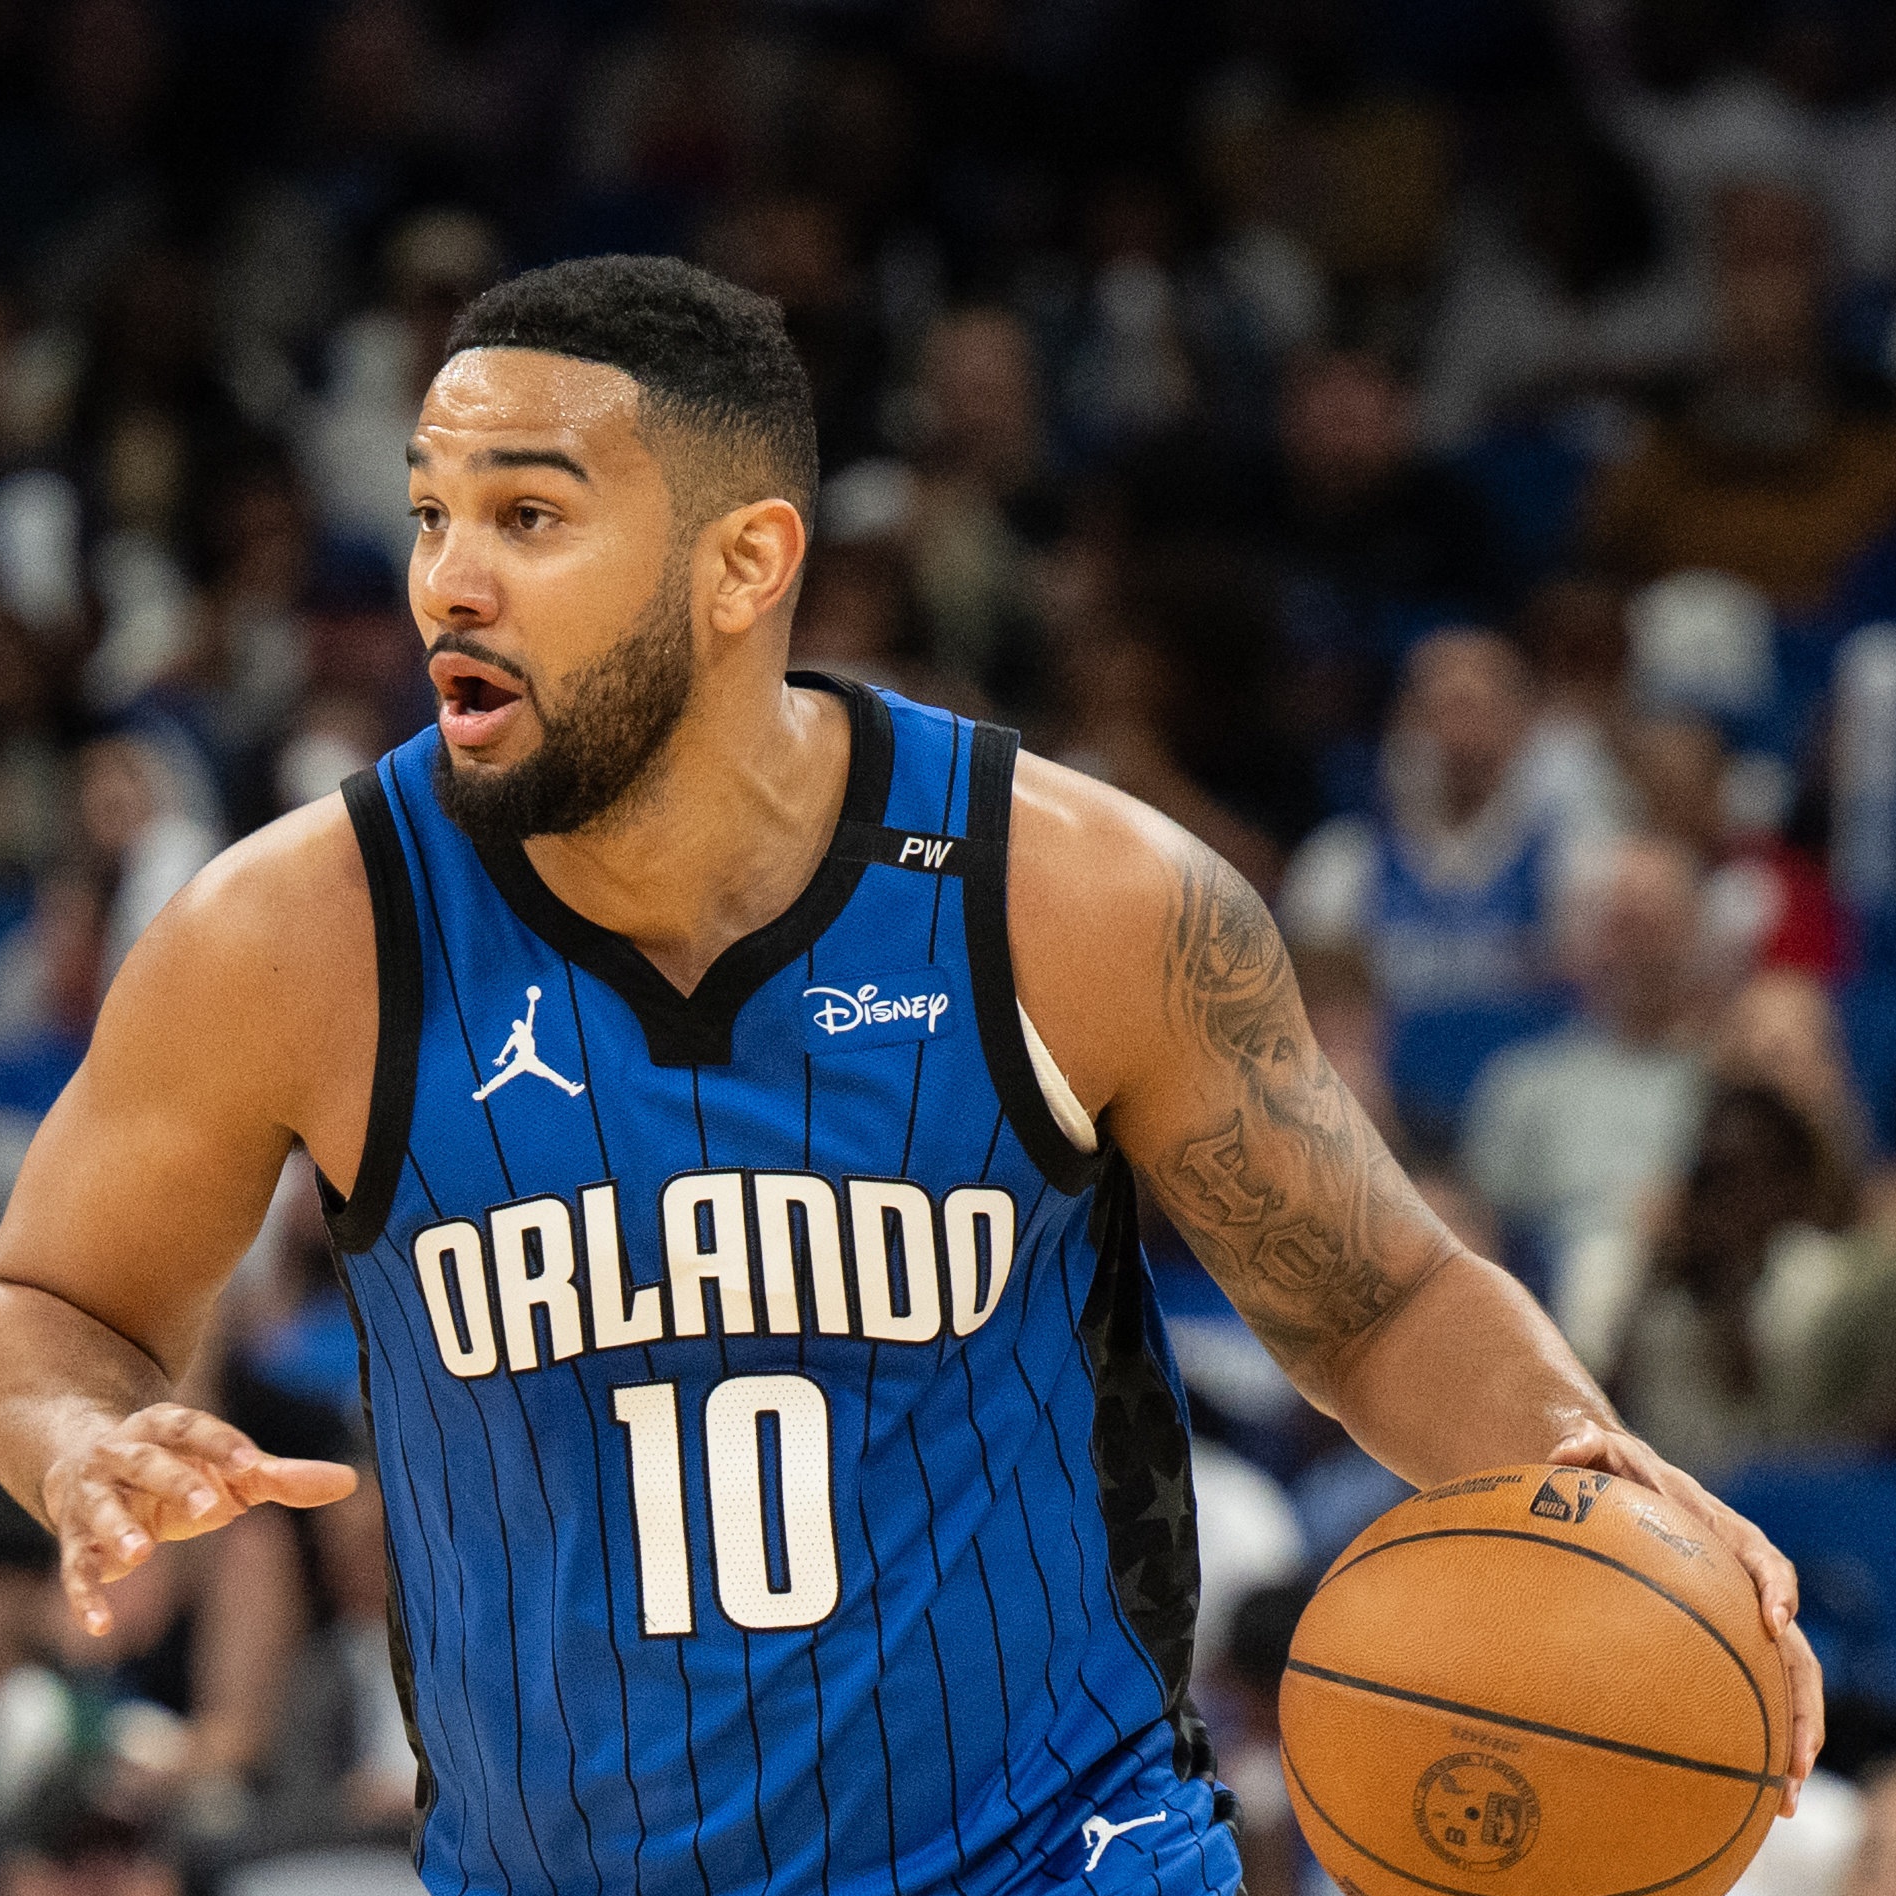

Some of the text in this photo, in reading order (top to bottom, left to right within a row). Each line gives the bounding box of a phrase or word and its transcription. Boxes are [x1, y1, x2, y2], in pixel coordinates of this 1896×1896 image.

[899, 837, 954, 868] PW
[803, 984, 949, 1035] Disney
[413, 1170, 1017, 1379] ORLANDO
[611, 1372, 843, 1637] 10
